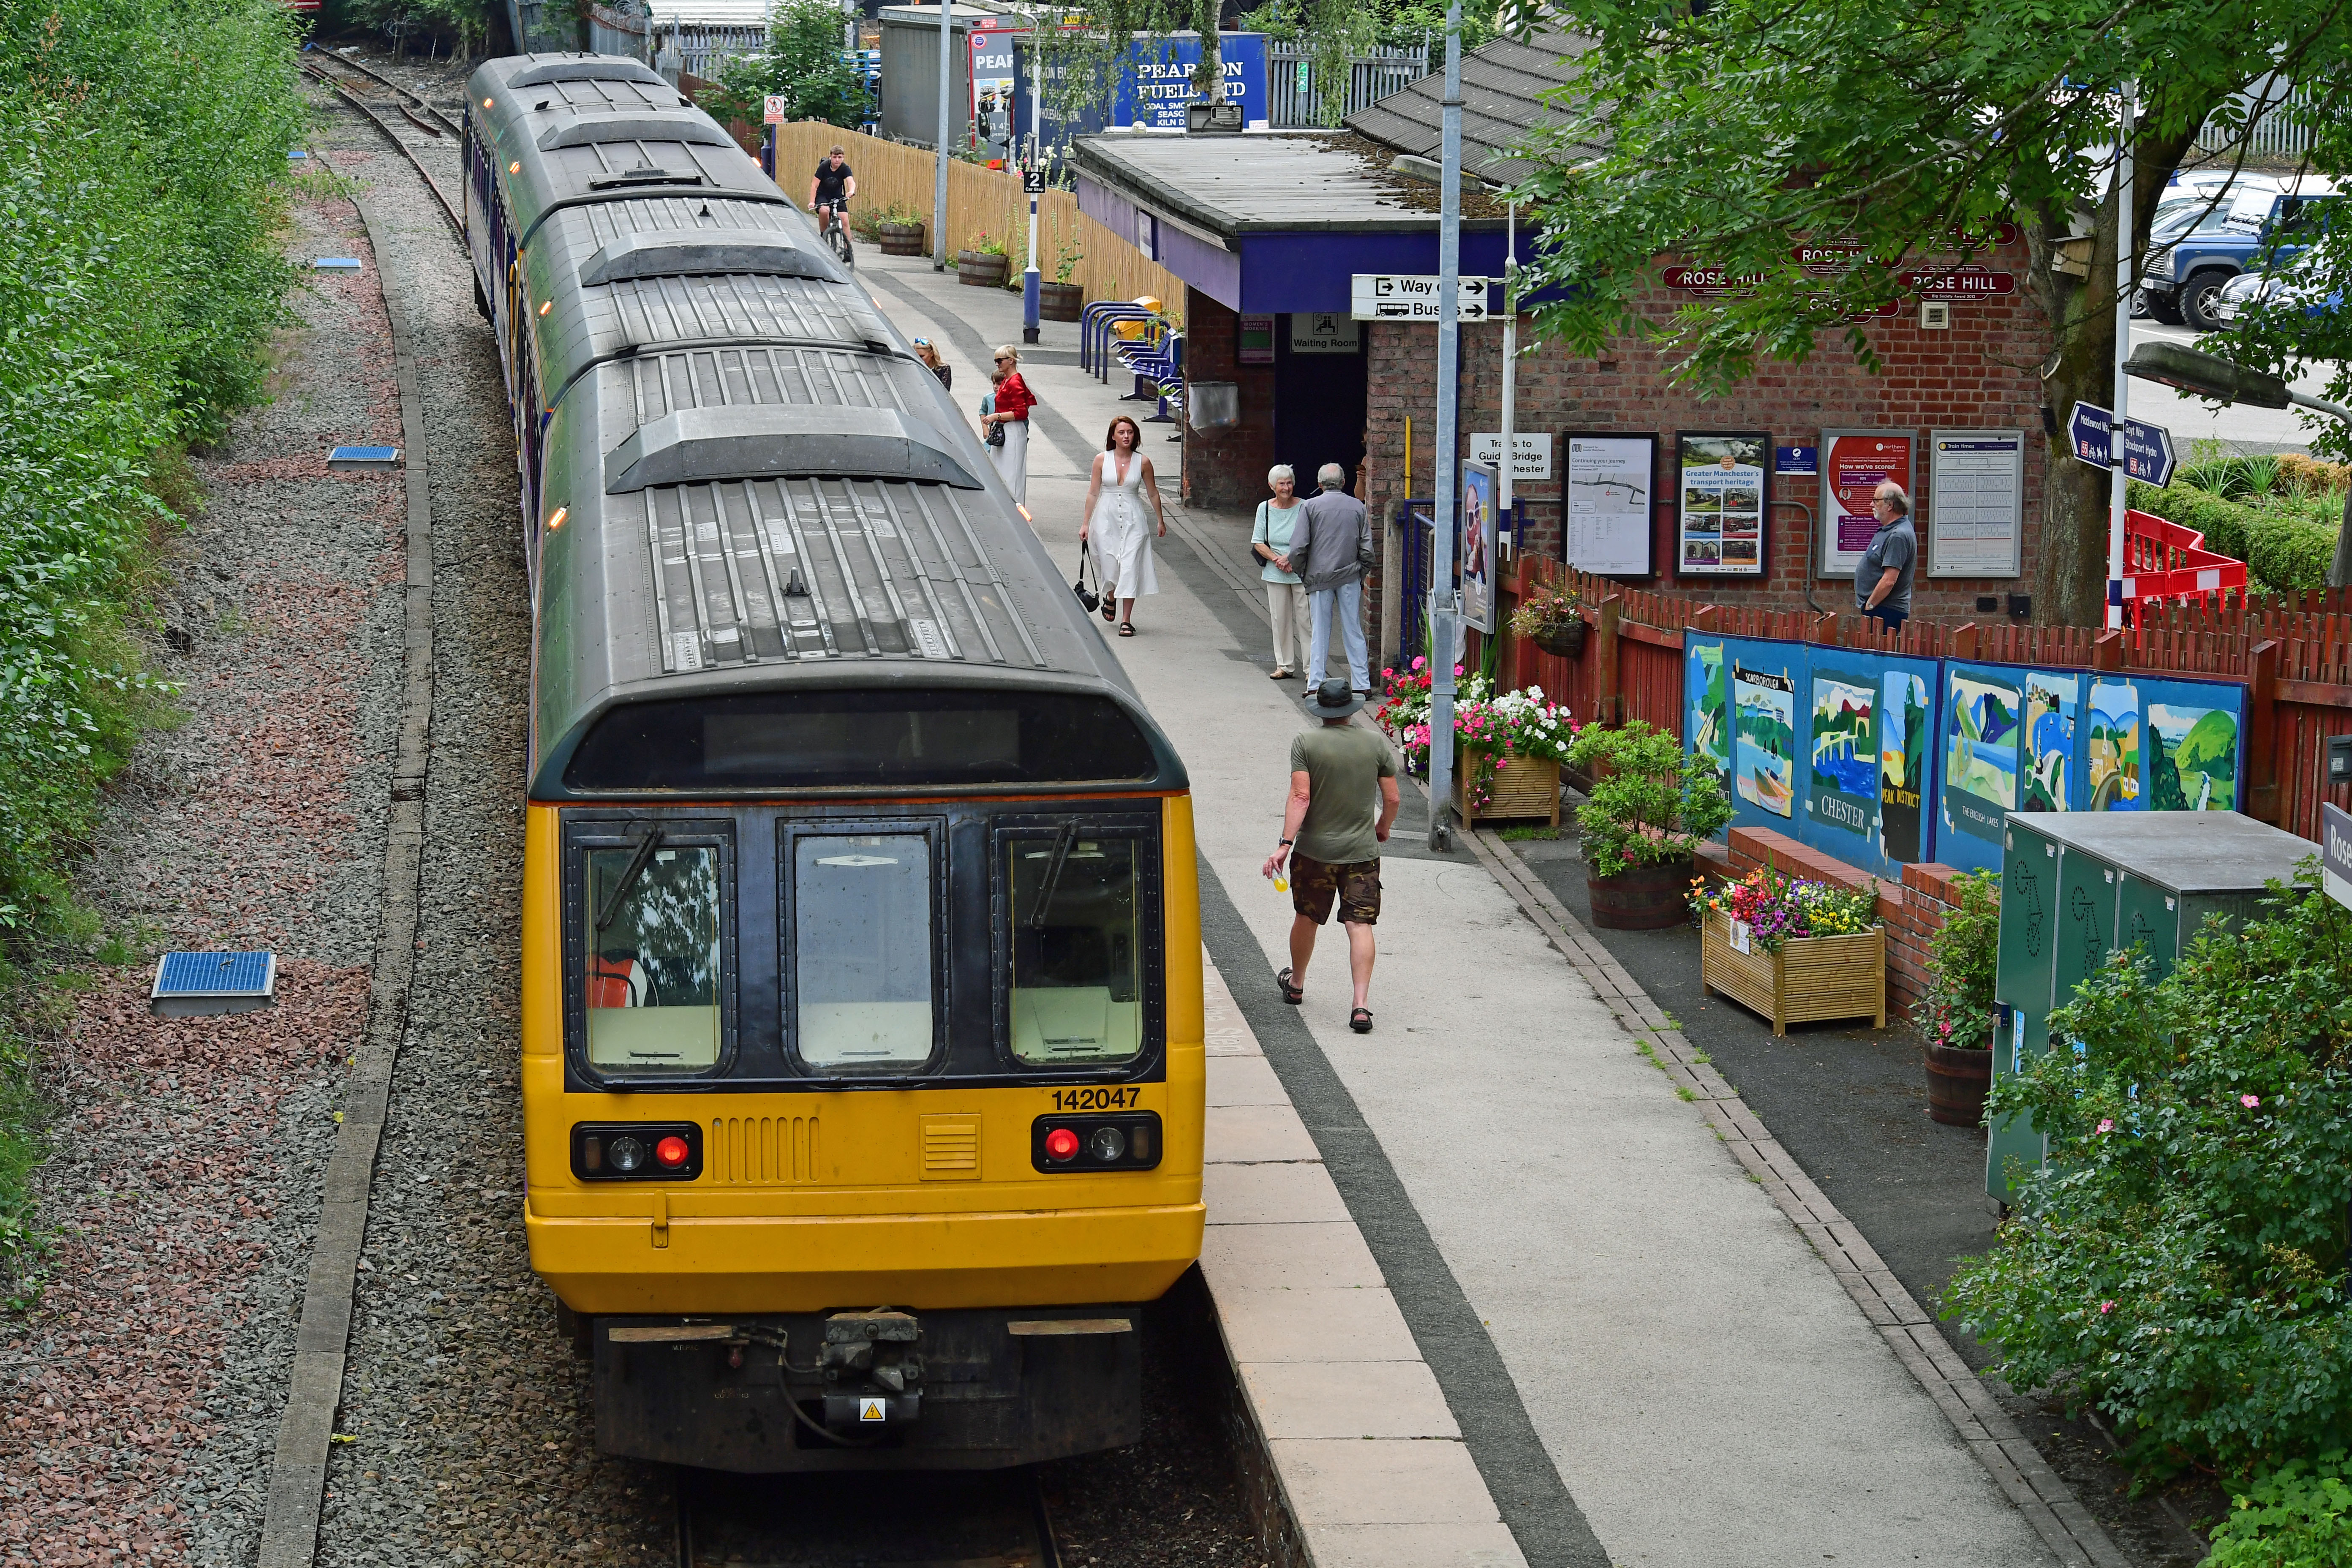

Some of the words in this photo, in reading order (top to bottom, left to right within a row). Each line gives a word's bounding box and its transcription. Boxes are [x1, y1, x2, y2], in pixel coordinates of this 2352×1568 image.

[976, 54, 1013, 69] PEAR
[1137, 62, 1244, 79] PEARN
[1029, 173, 1040, 187] 2
[1683, 272, 1726, 285] ROSE
[1913, 276, 1955, 289] ROSE
[1963, 277, 1996, 290] HILL
[1400, 280, 1432, 295] Way
[1414, 302, 1461, 316] Buss
[1293, 339, 1327, 348] Waiting
[1331, 339, 1357, 347] Room
[2080, 414, 2102, 430] Middlewood
[2125, 423, 2135, 436] Goyt
[2136, 426, 2145, 440] Way
[1490, 440, 1518, 448] Tras
[1522, 440, 1532, 448] to
[2082, 444, 2088, 454] 55
[2125, 438, 2145, 454] Stockport
[2145, 444, 2157, 458] Hydro
[1479, 452, 1501, 460] Guid
[1512, 452, 1542, 462] Bridge
[2131, 460, 2137, 471] 55
[1745, 672, 1779, 689] SCARBOROUGH
[1882, 787, 1894, 804] PEAK
[1897, 789, 1920, 808] DISTRICT
[1821, 795, 1864, 829] CHESTER
[1970, 808, 1985, 823] ENGLISH
[1987, 816, 1998, 828] LAKES
[2330, 824, 2352, 869] Rose
[1052, 1087, 1141, 1110] 142047
